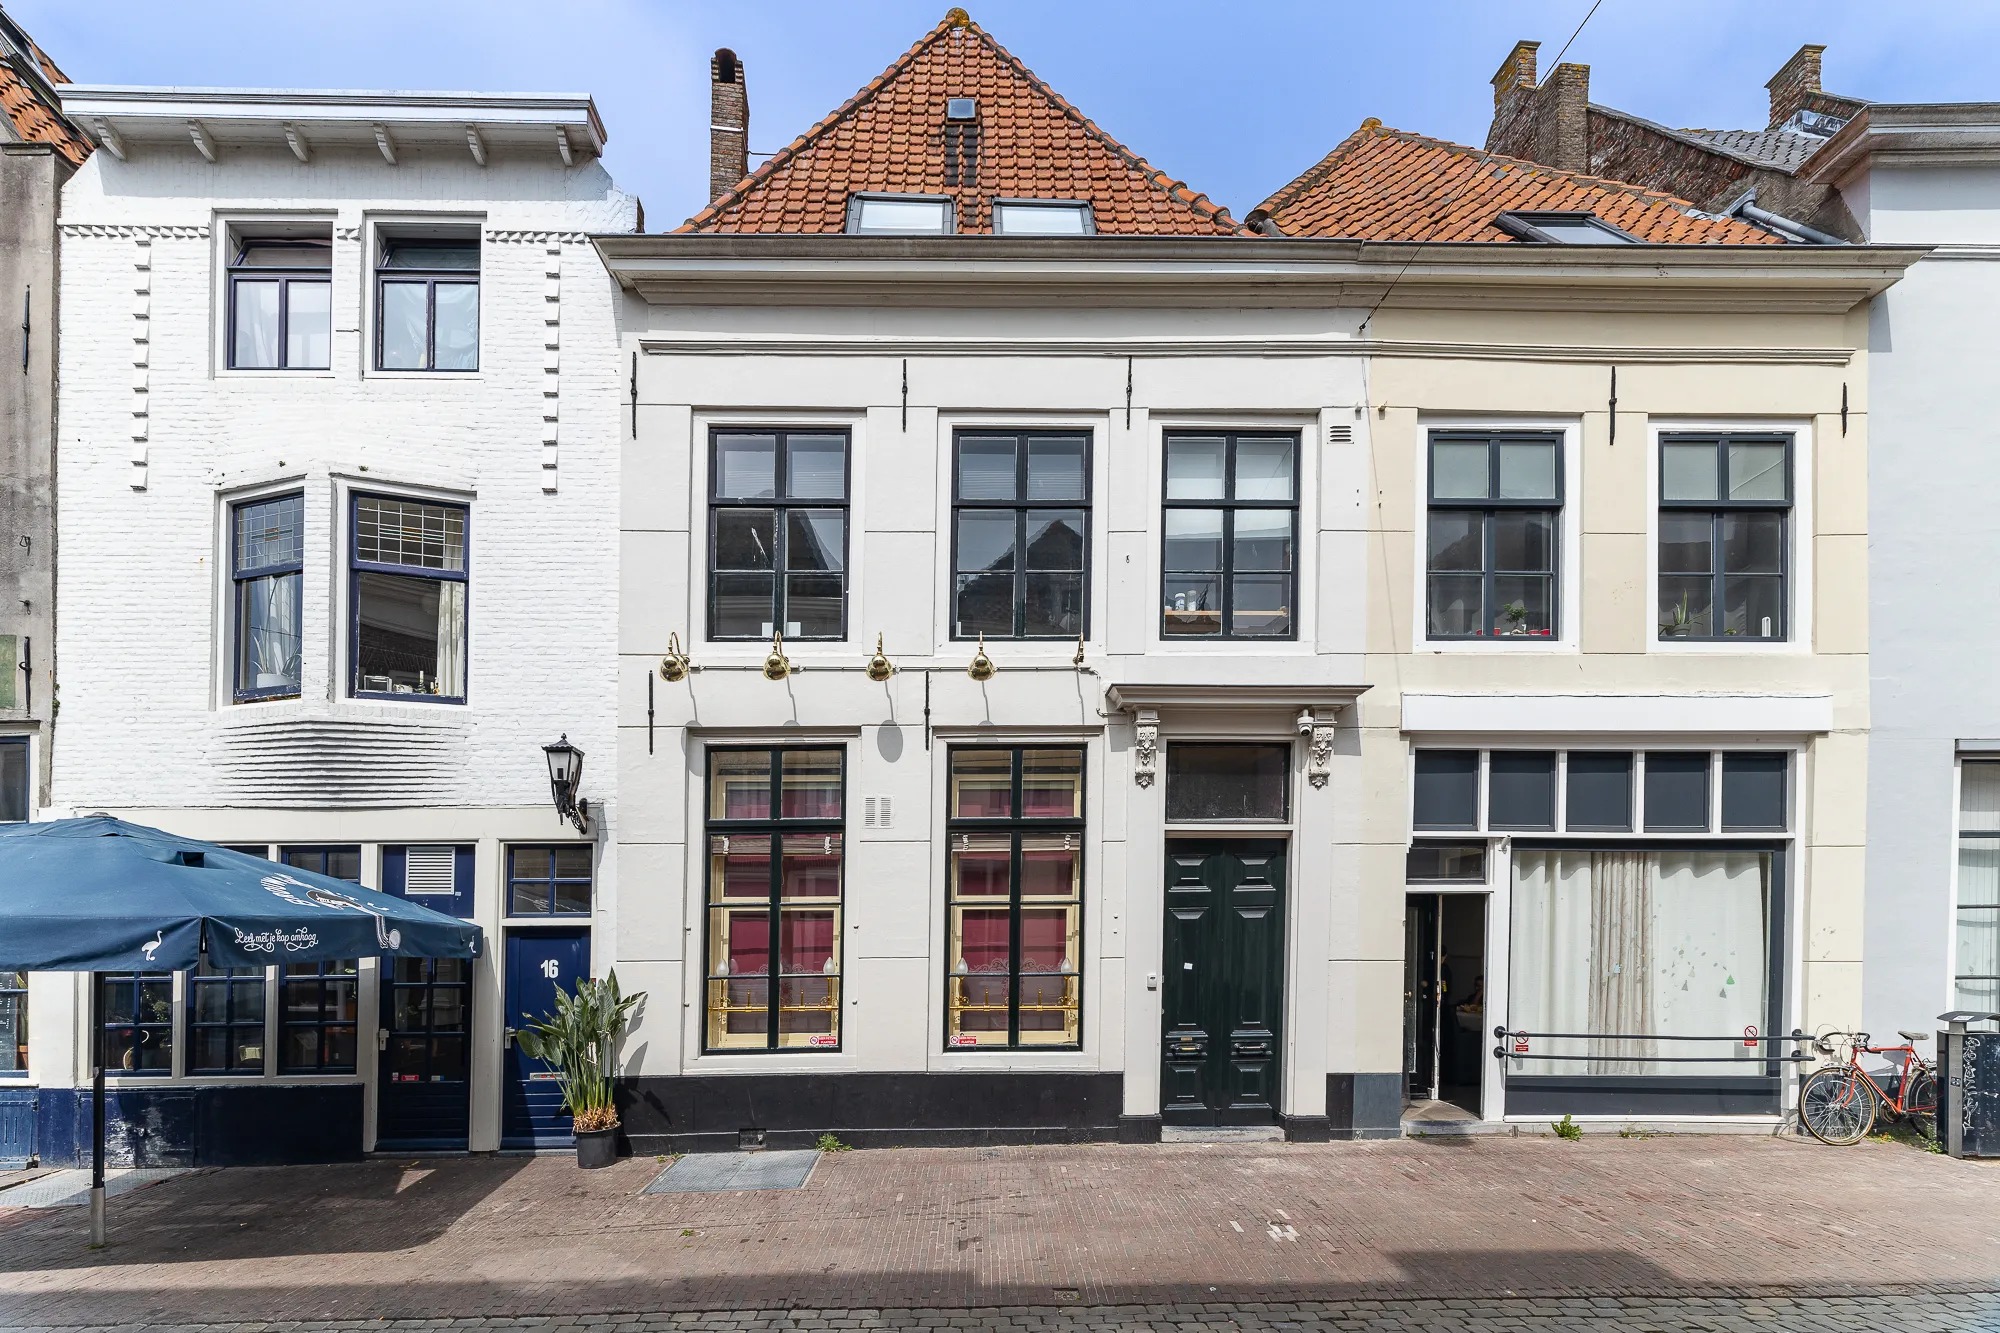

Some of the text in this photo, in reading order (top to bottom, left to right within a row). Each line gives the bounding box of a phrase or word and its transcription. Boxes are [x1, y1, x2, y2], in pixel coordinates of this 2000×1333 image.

[235, 927, 255, 948] Leef
[255, 932, 269, 943] met
[540, 959, 559, 979] 16
